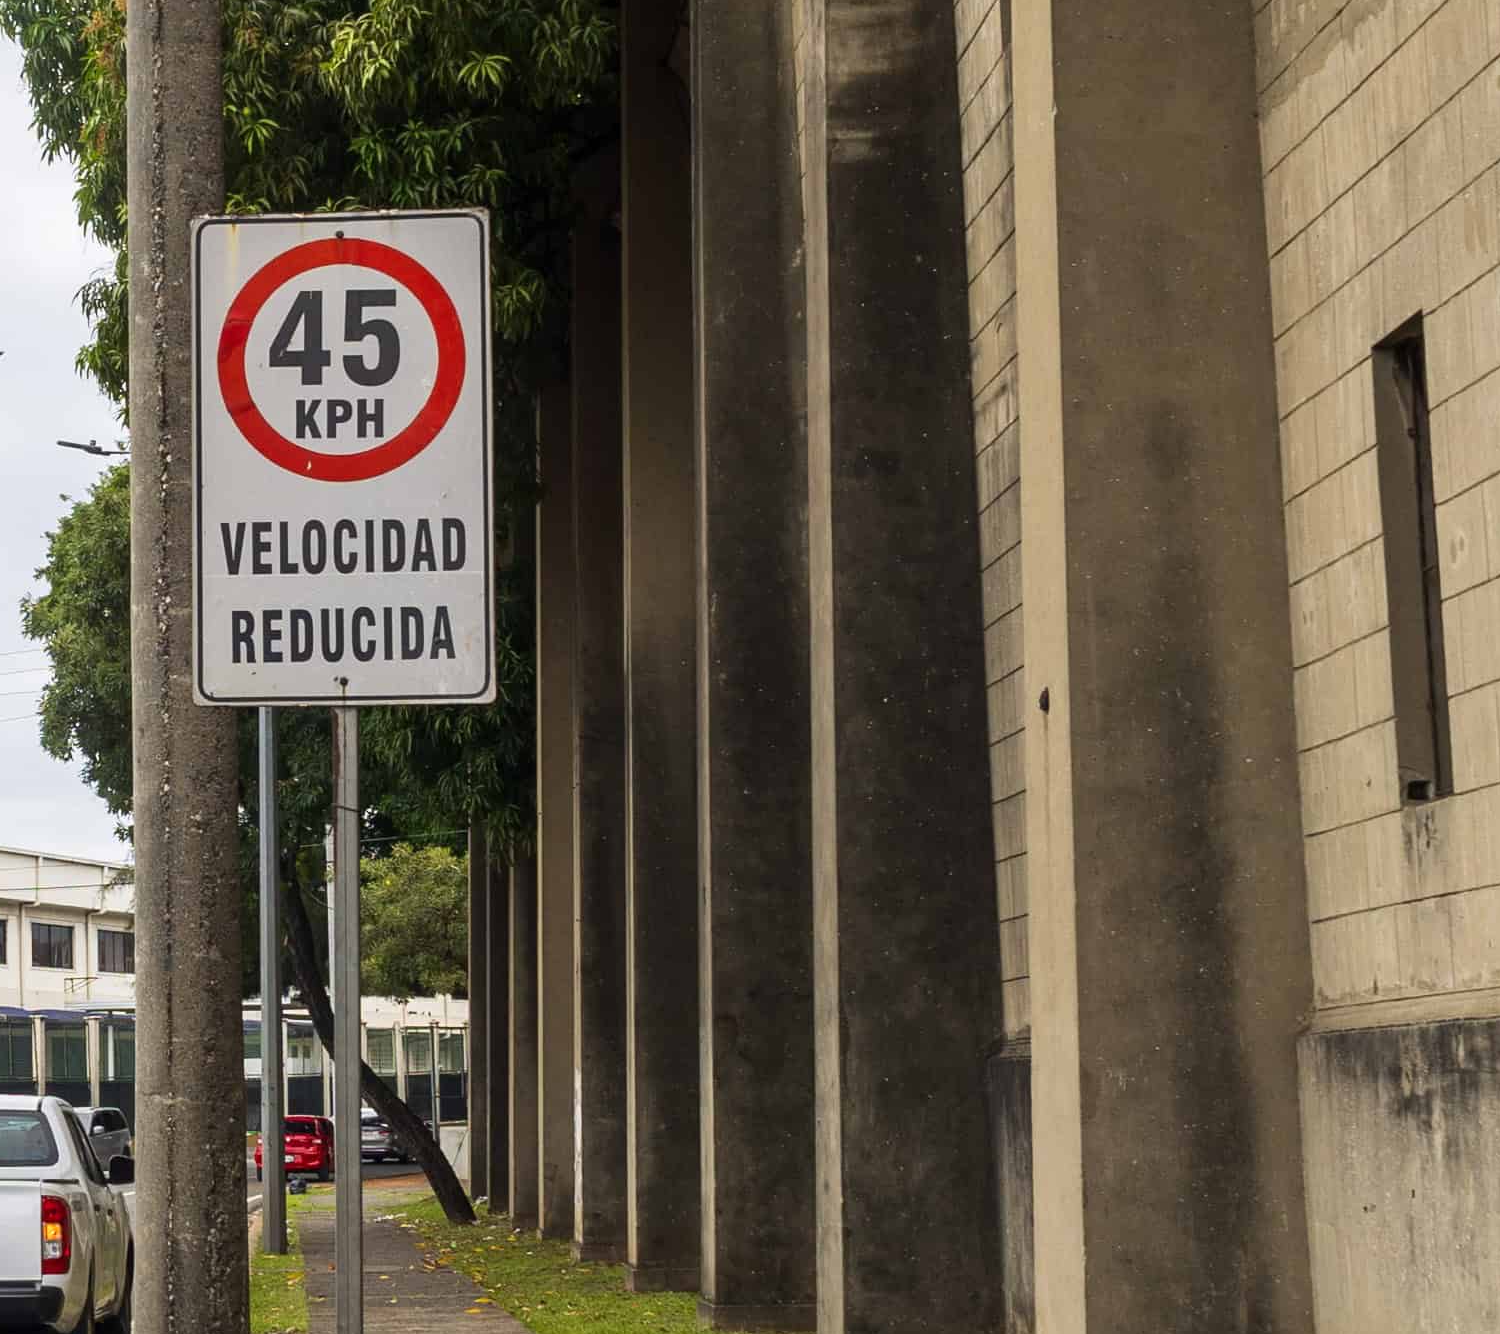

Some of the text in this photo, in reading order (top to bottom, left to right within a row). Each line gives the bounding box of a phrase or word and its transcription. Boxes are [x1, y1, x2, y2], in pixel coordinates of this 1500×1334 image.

[268, 289, 401, 387] 45
[294, 398, 385, 439] KPH
[220, 518, 466, 576] VELOCIDAD
[231, 605, 456, 664] REDUCIDA
